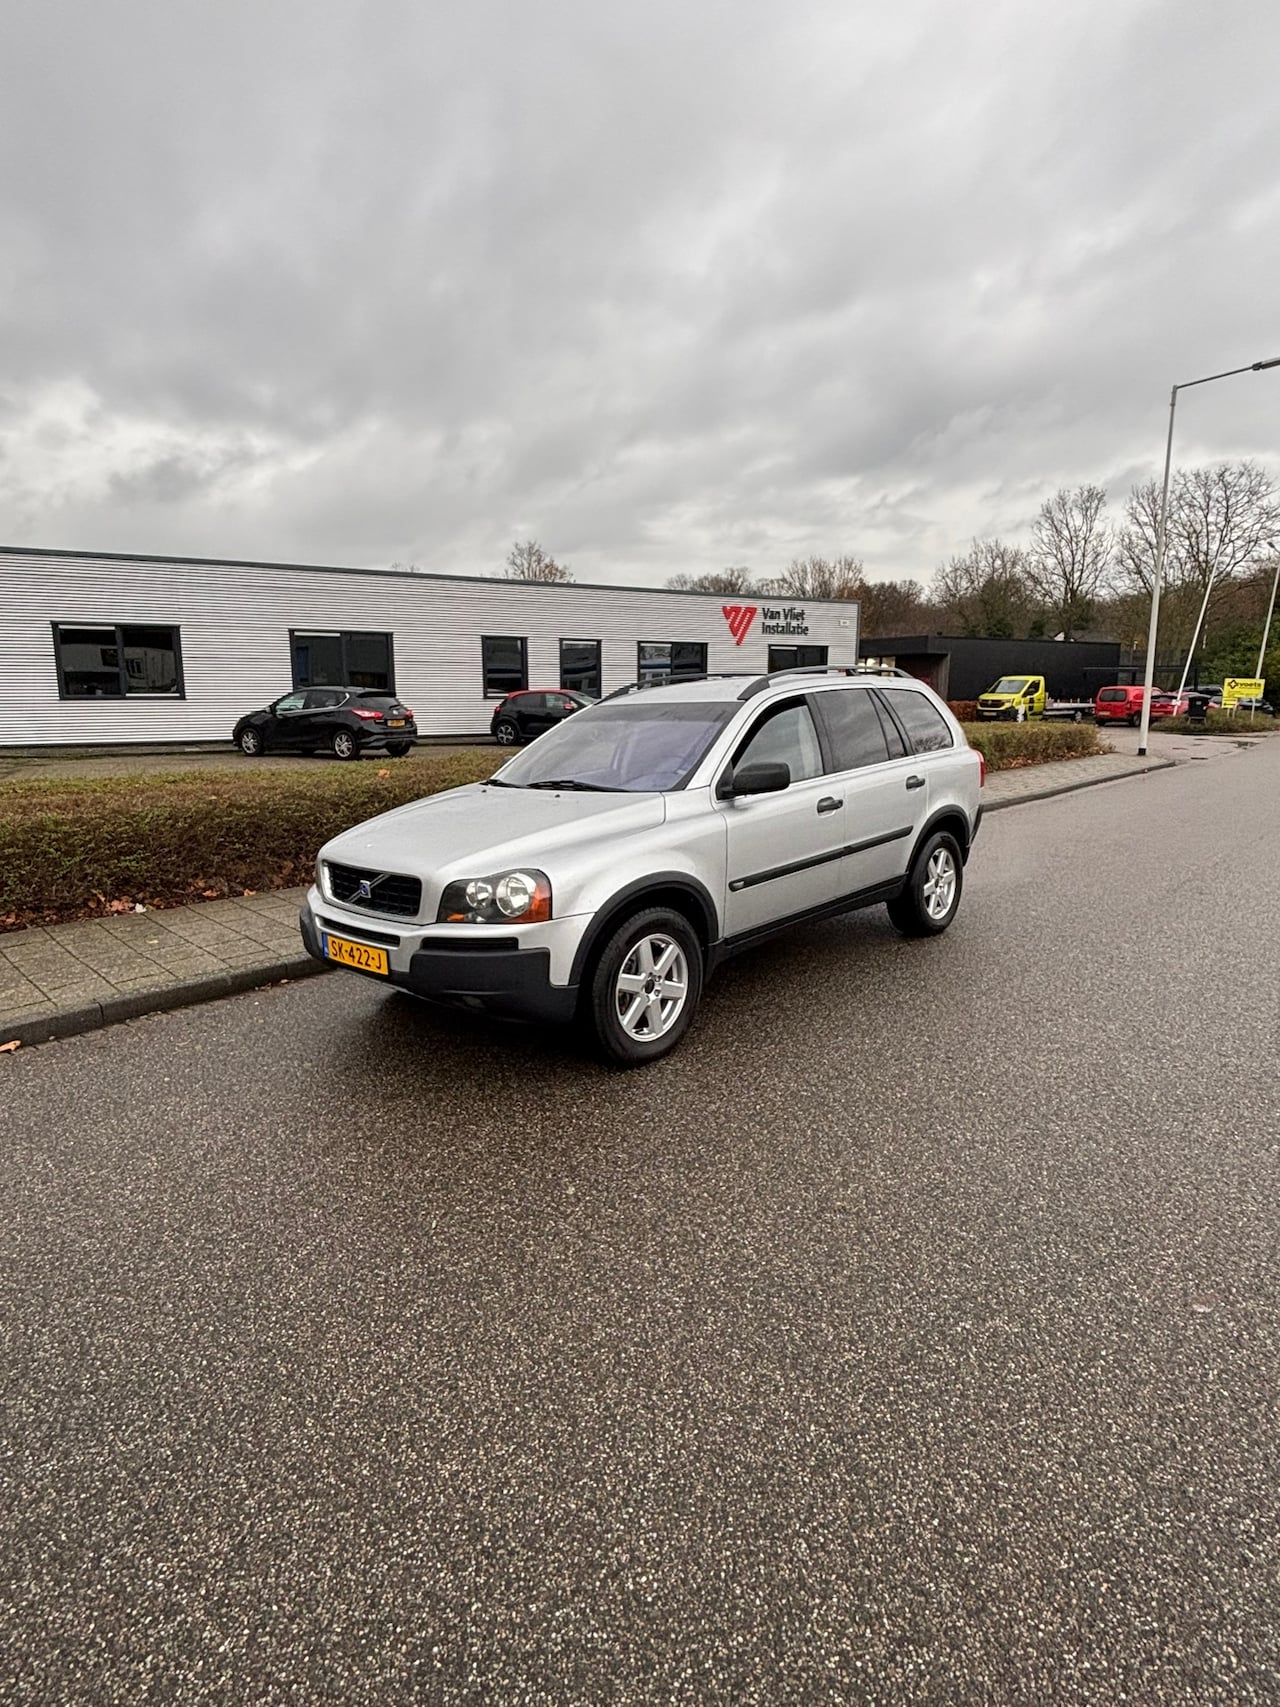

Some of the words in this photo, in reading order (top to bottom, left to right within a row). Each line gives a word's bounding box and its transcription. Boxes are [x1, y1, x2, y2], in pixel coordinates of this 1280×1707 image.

[762, 608, 780, 620] Van
[783, 607, 805, 620] Vliet
[762, 622, 809, 635] Installatie
[331, 940, 382, 970] SK-422-J
